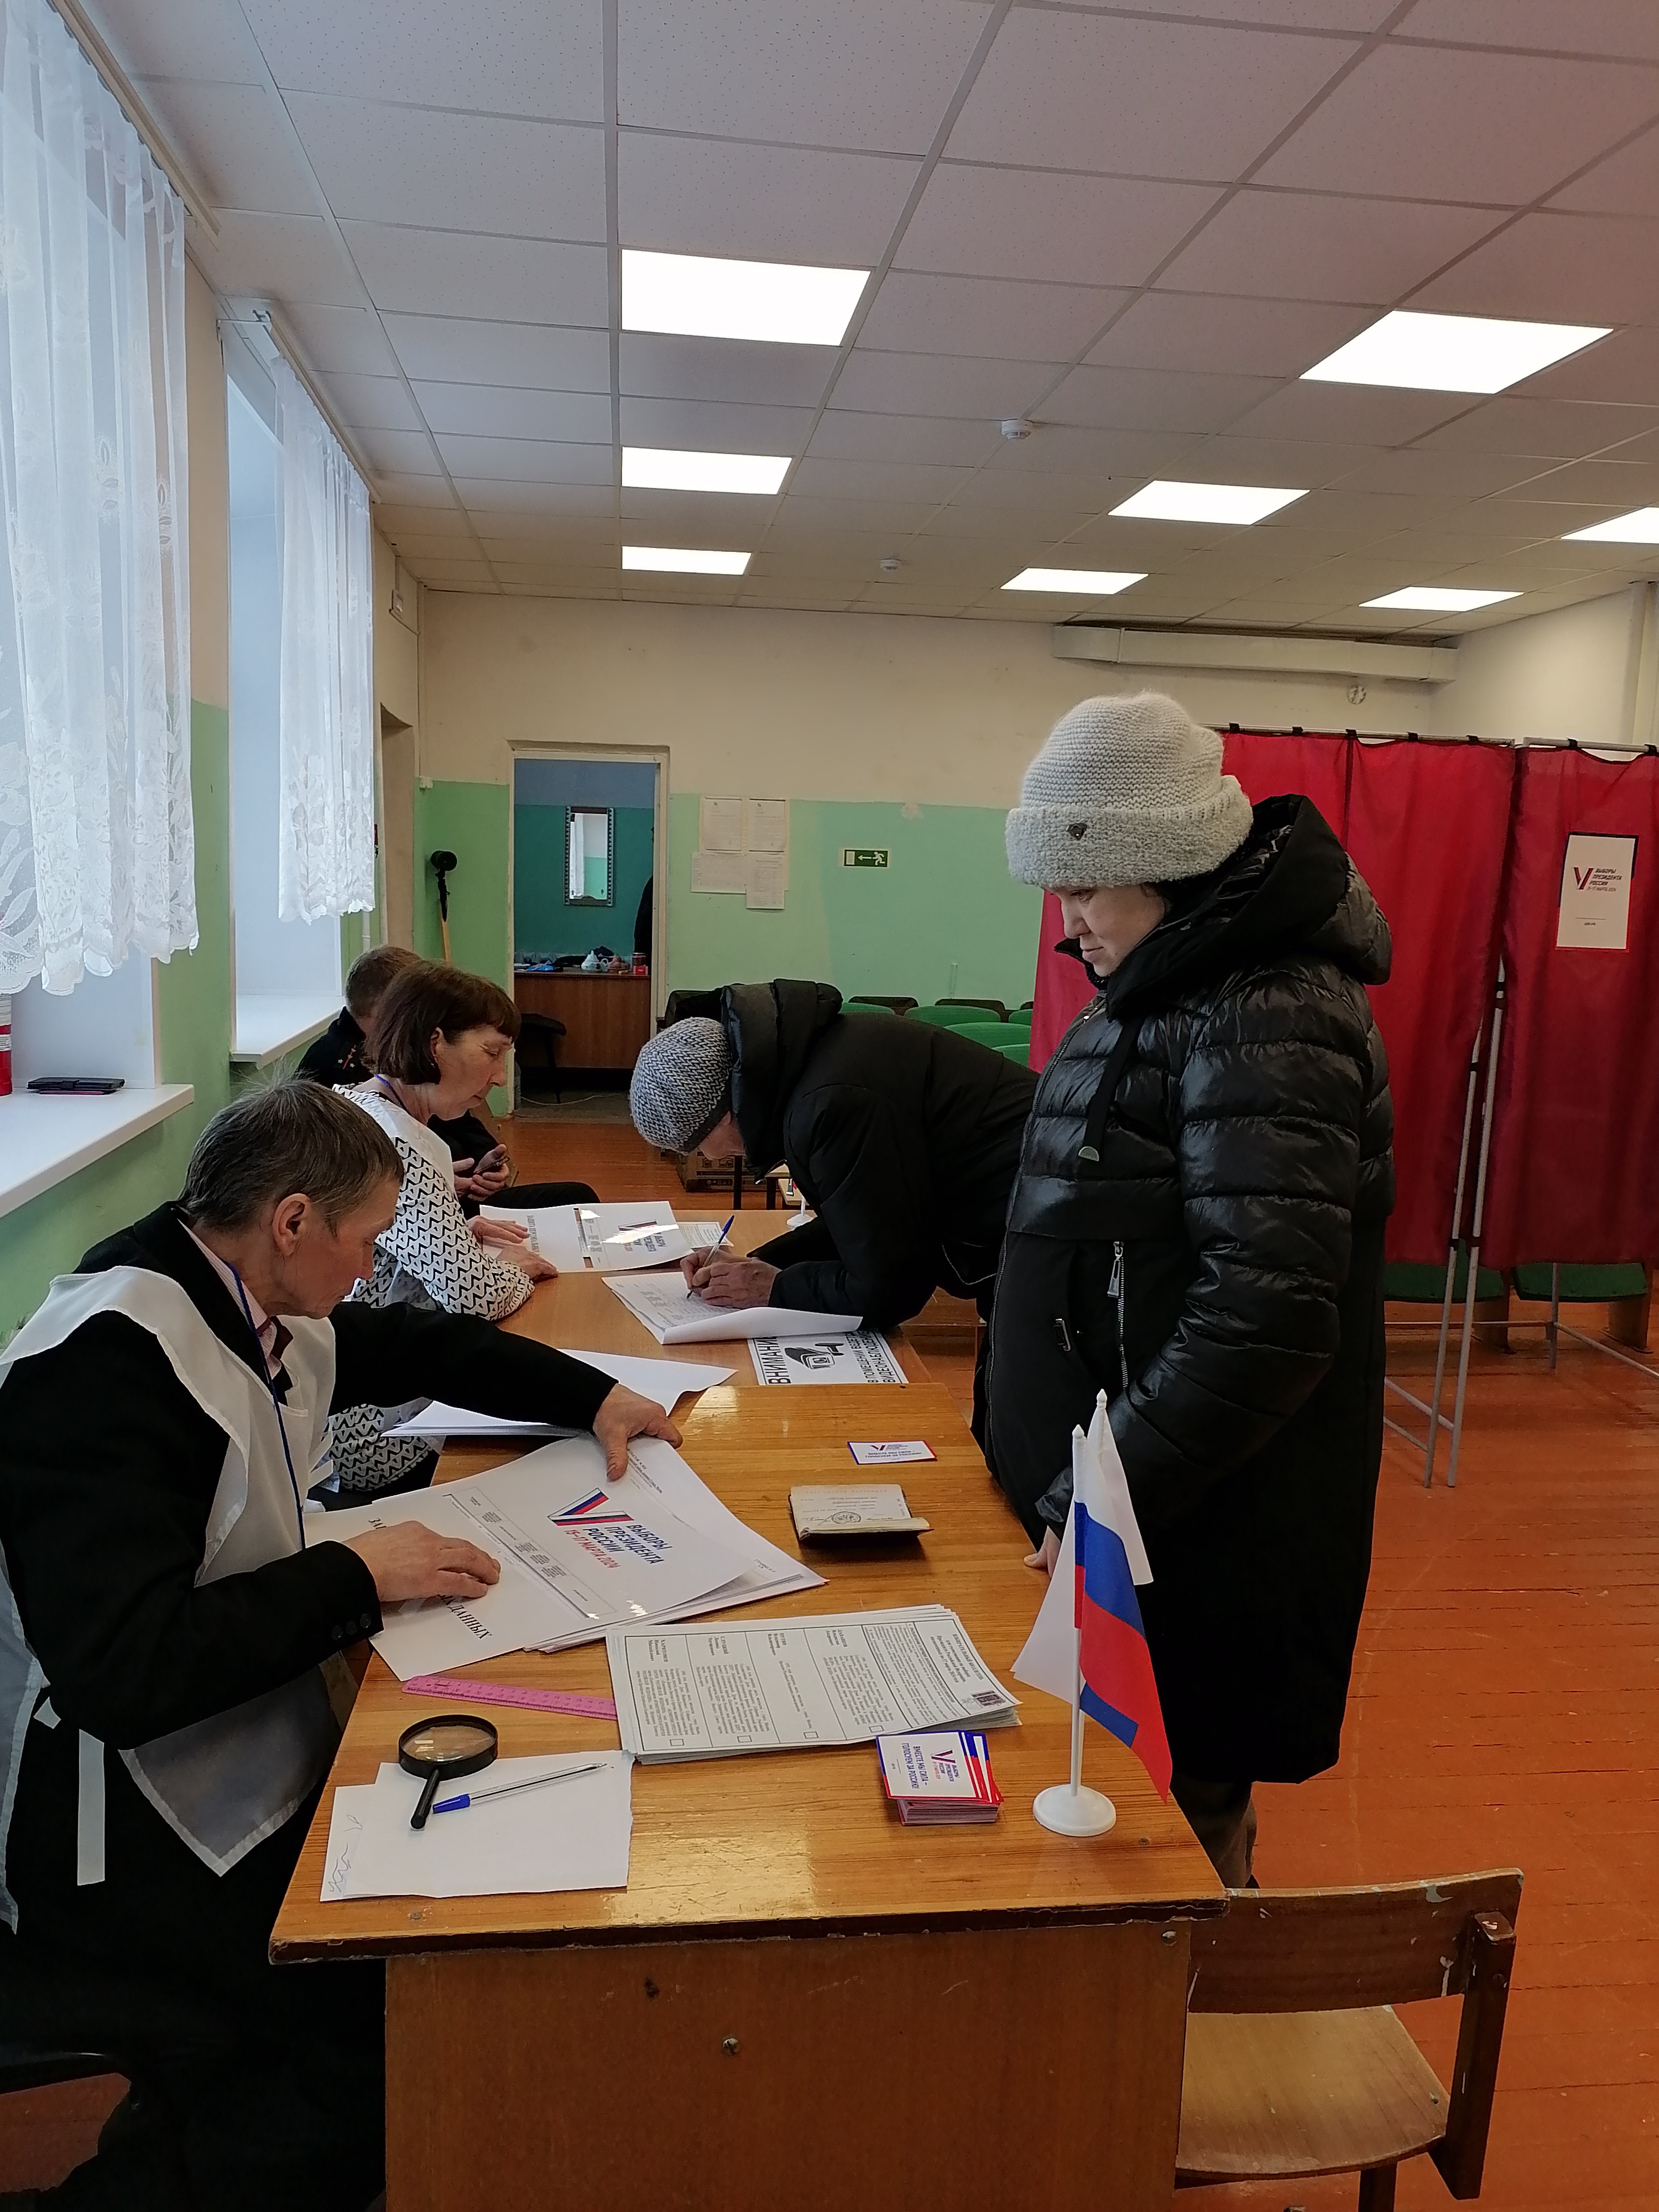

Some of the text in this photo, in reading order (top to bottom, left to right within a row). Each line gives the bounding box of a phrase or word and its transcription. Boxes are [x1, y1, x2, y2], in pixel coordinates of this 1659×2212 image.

[755, 1336, 791, 1384] ВНИМАНИЕ
[852, 1350, 877, 1379] ПОМЕЩЕНИИ
[583, 1528, 625, 1552] РОССИИ
[604, 1526, 665, 1564] ПРЕЗИДЕНТА
[626, 1525, 673, 1550] ВЫБОРЫ
[578, 1541, 607, 1559] МАРТА
[597, 1556, 621, 1568] 2024
[449, 1604, 493, 1640] ДАННЫХ
[660, 1639, 669, 1663] ХАРИТОНОВ
[901, 1743, 914, 1765] ГОЛОСУЕМ
[913, 1746, 924, 1762] ВМЕСТЕ
[917, 1762, 926, 1770] МЫ
[919, 1771, 929, 1782] СИЛА
